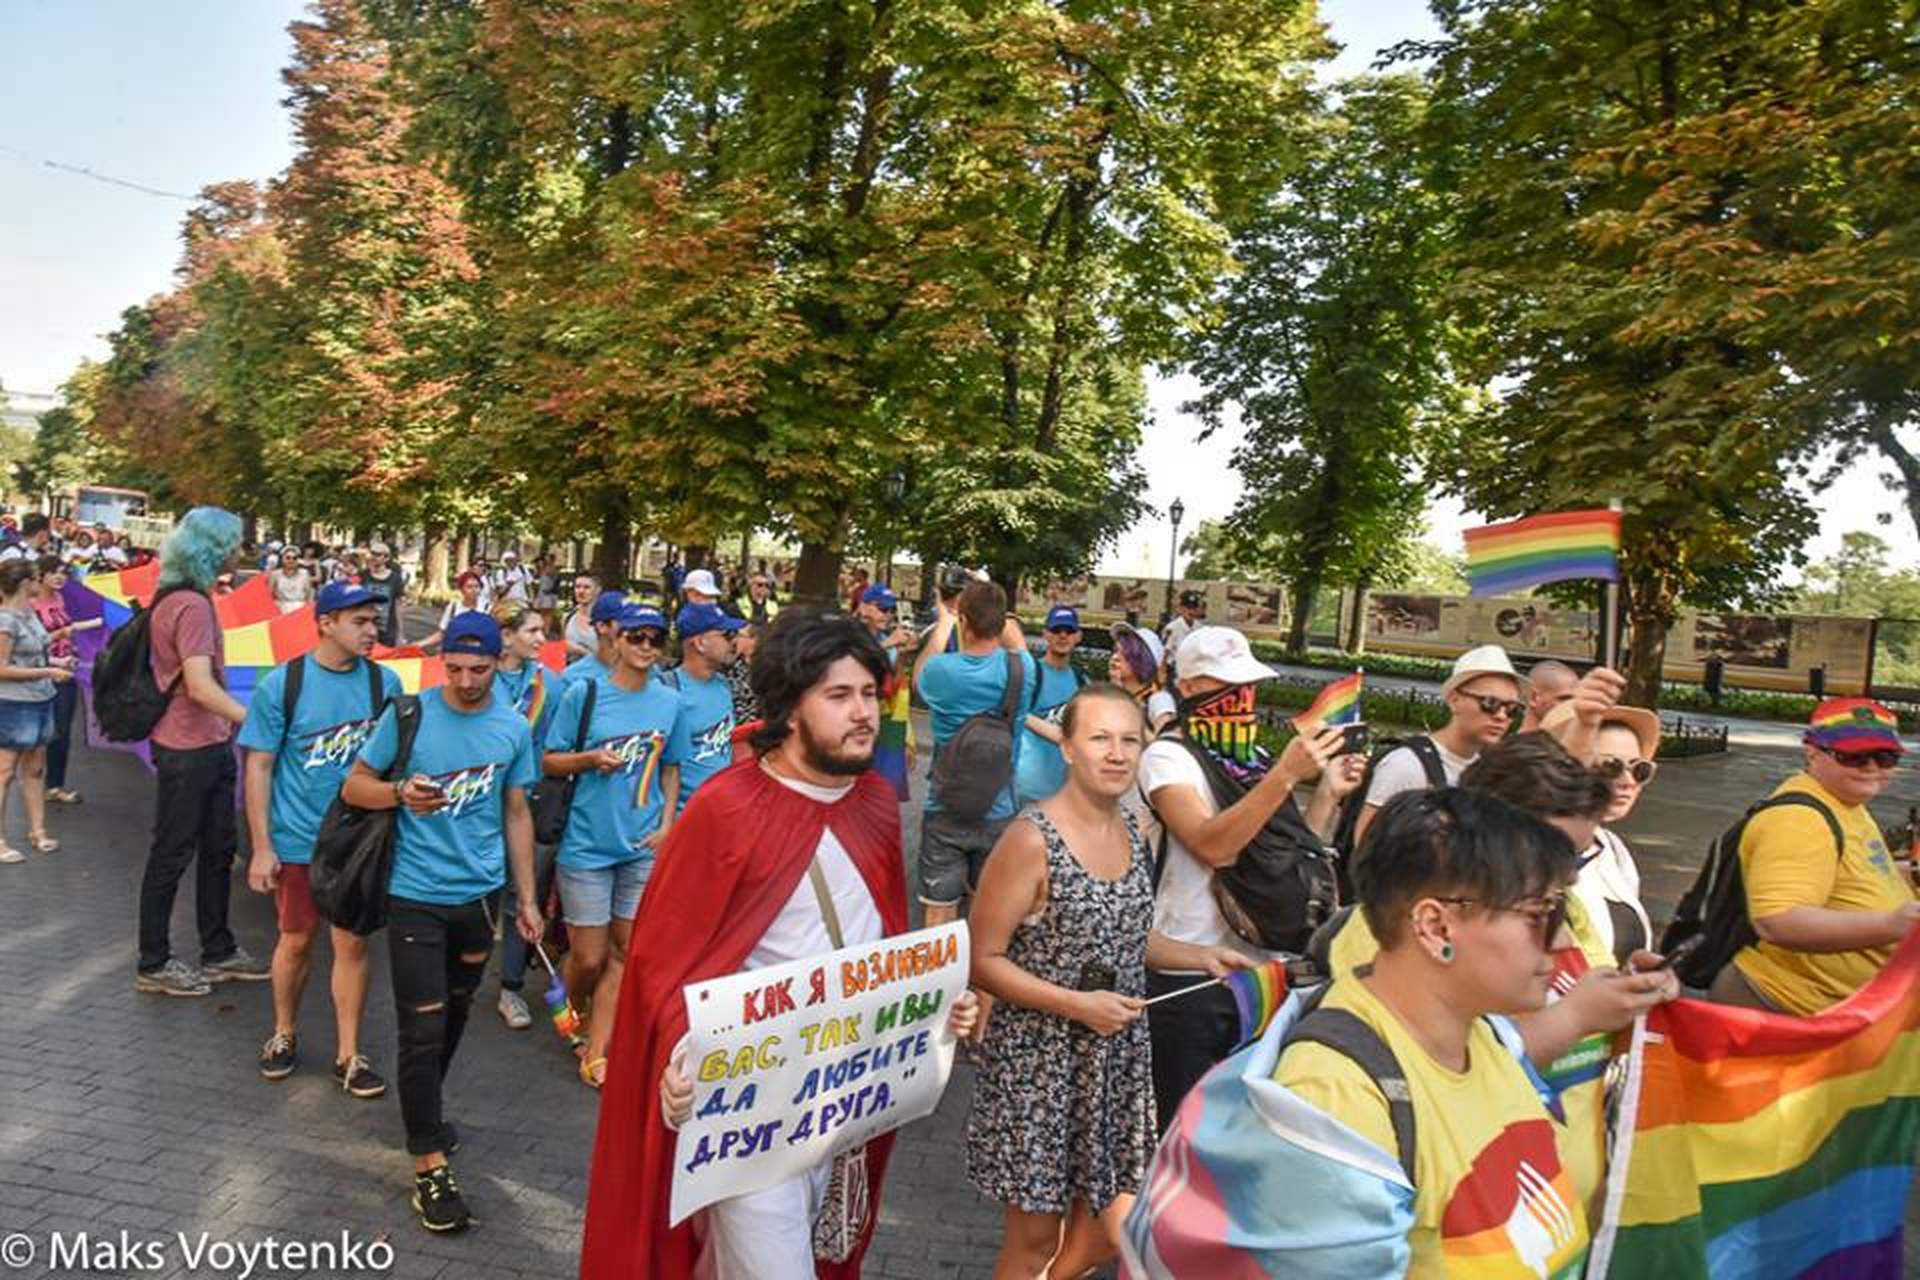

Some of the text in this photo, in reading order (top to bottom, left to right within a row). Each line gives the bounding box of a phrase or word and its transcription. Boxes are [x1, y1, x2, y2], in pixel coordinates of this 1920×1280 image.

[743, 976, 797, 1025] КАК
[805, 966, 826, 1007] Я
[799, 1013, 862, 1055] ТАК
[696, 1030, 930, 1120] ДА ЛЮБИТЕ
[686, 1119, 783, 1174] ДРУГ
